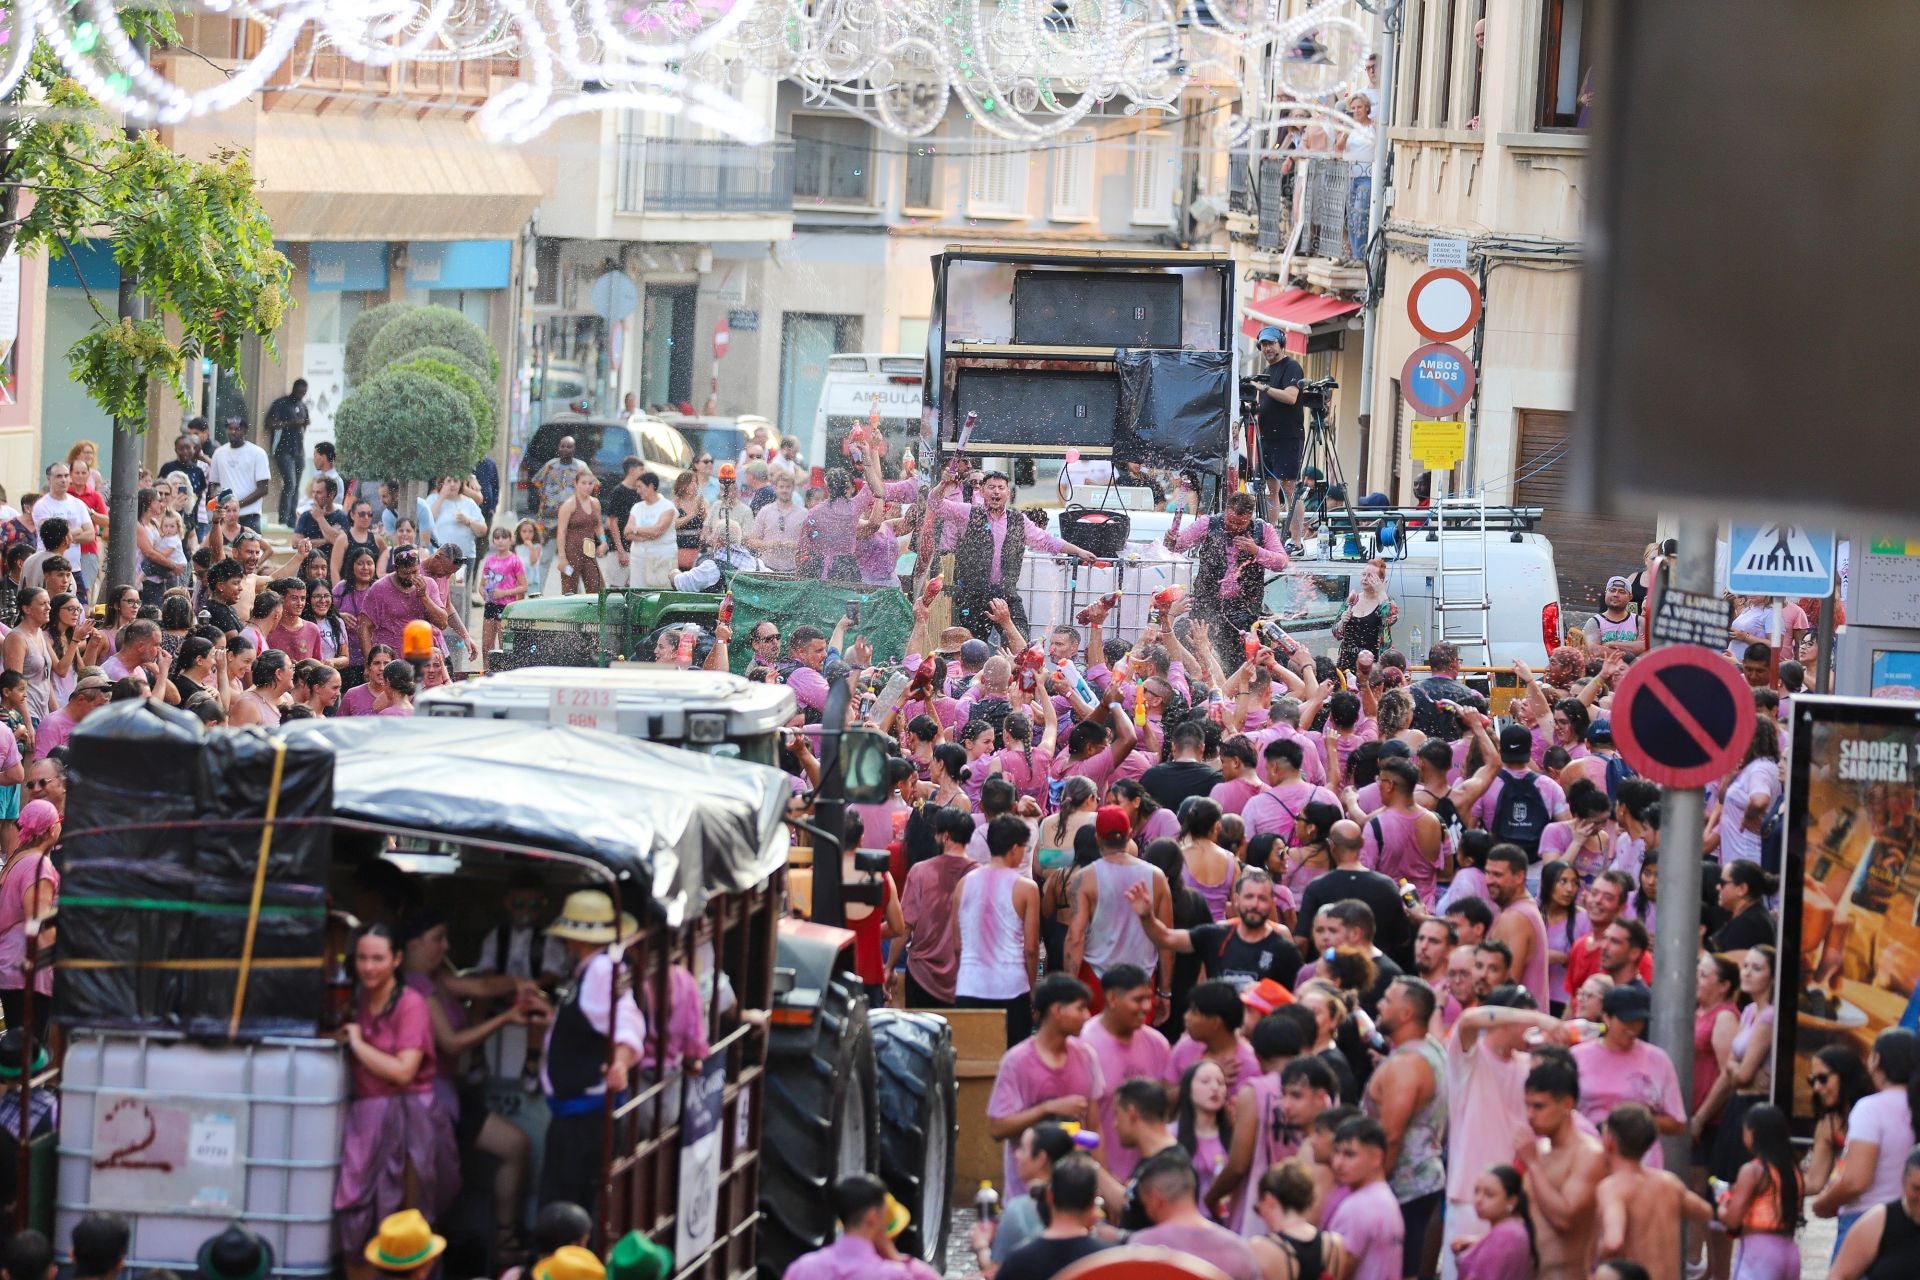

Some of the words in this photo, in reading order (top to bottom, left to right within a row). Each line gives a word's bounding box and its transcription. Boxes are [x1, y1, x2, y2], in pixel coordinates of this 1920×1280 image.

[1419, 360, 1459, 370] AMBOS
[1420, 370, 1458, 380] LADOS
[1665, 590, 1685, 605] DE
[1685, 594, 1730, 613] LUNES
[1660, 603, 1672, 617] A
[1672, 605, 1729, 627] VIERNES
[557, 688, 566, 705] E
[571, 688, 609, 706] 2213
[1840, 739, 1908, 763] SABOREA
[1839, 759, 1907, 783] SABOREA
[94, 1098, 173, 1173] 2
